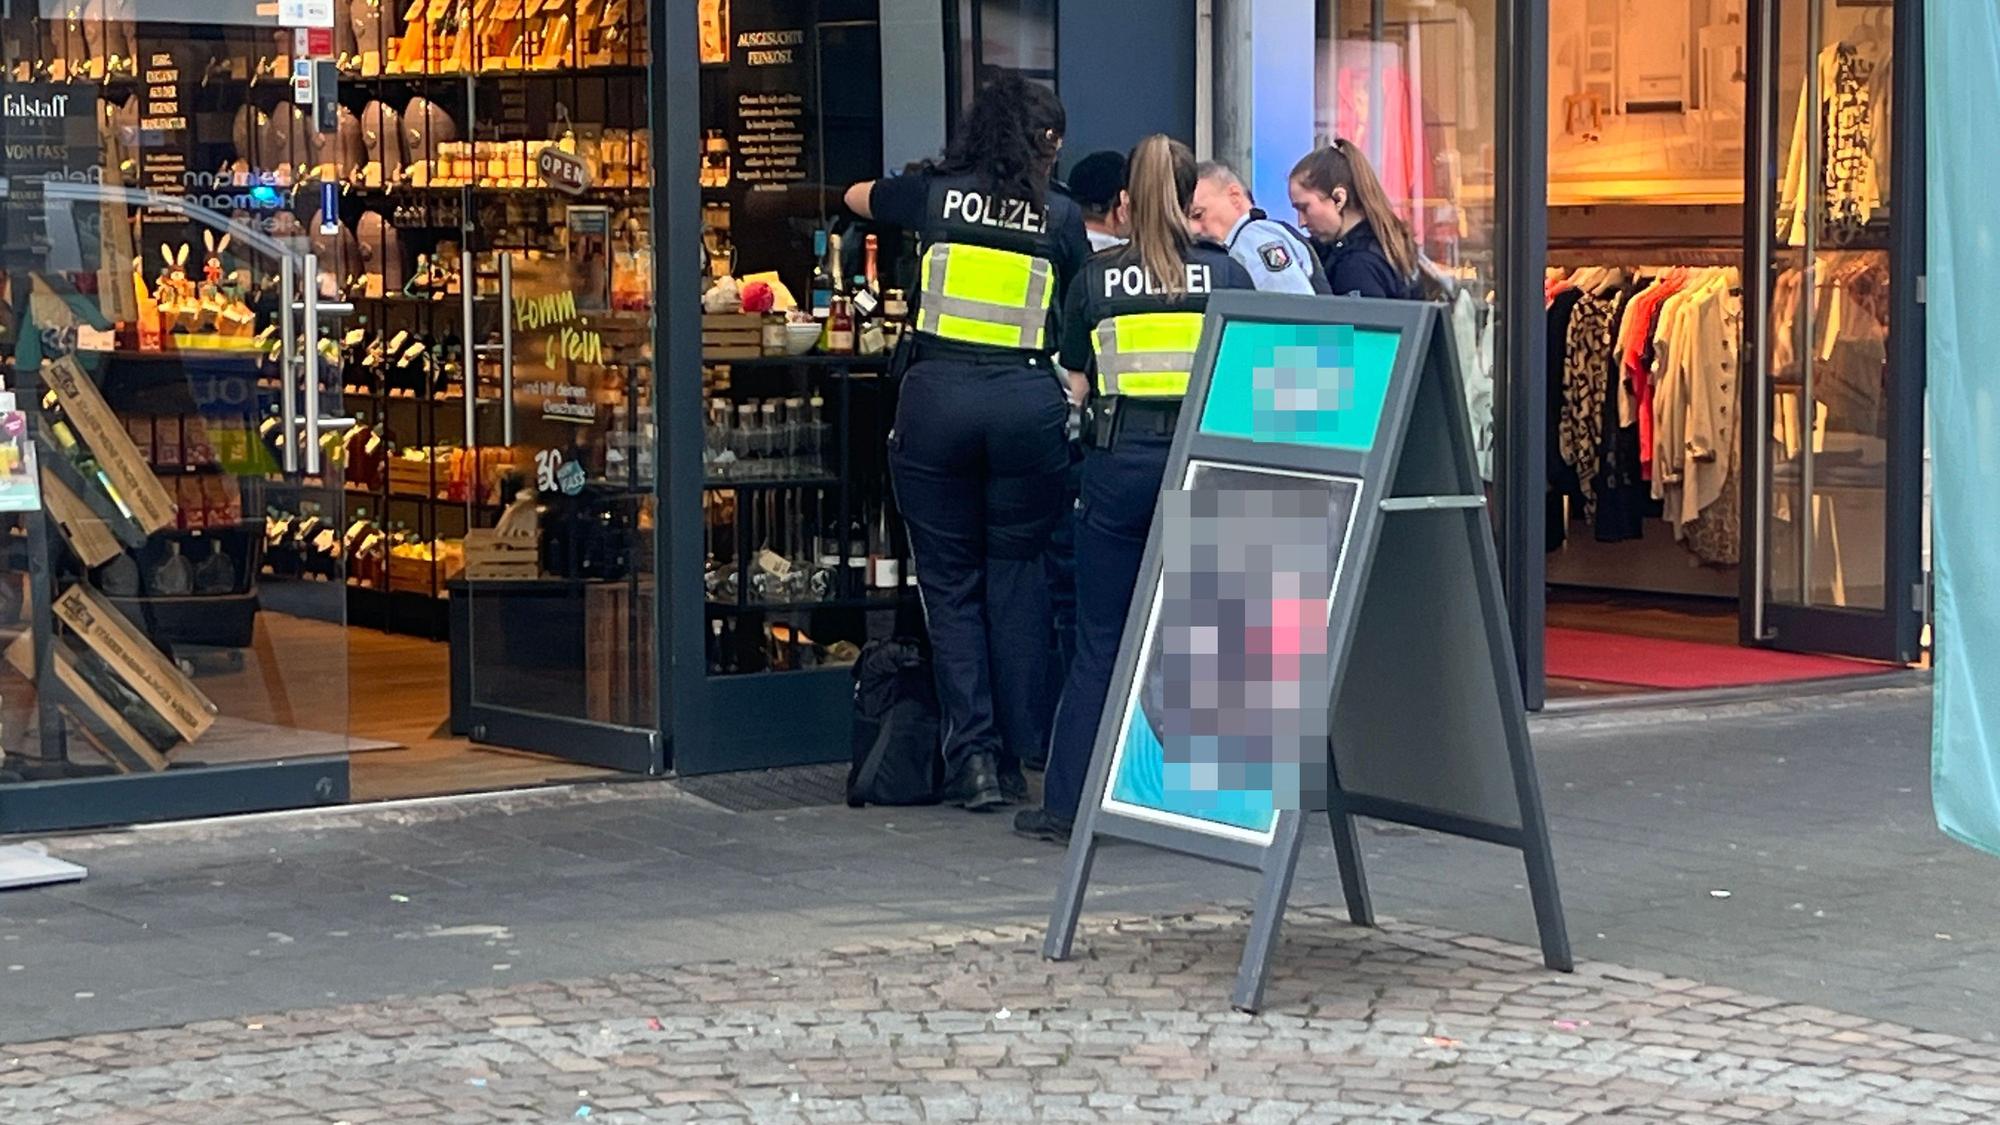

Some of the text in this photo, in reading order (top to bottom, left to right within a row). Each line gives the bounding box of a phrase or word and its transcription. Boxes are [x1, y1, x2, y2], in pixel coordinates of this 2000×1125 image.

[737, 30, 803, 47] AUSGESUCHTE
[3, 94, 69, 117] falstaff
[5, 145, 69, 160] VOM FASS
[541, 154, 584, 183] OPEN
[1104, 263, 1212, 298] POLEI
[513, 290, 577, 331] Komm
[560, 317, 605, 367] rein
